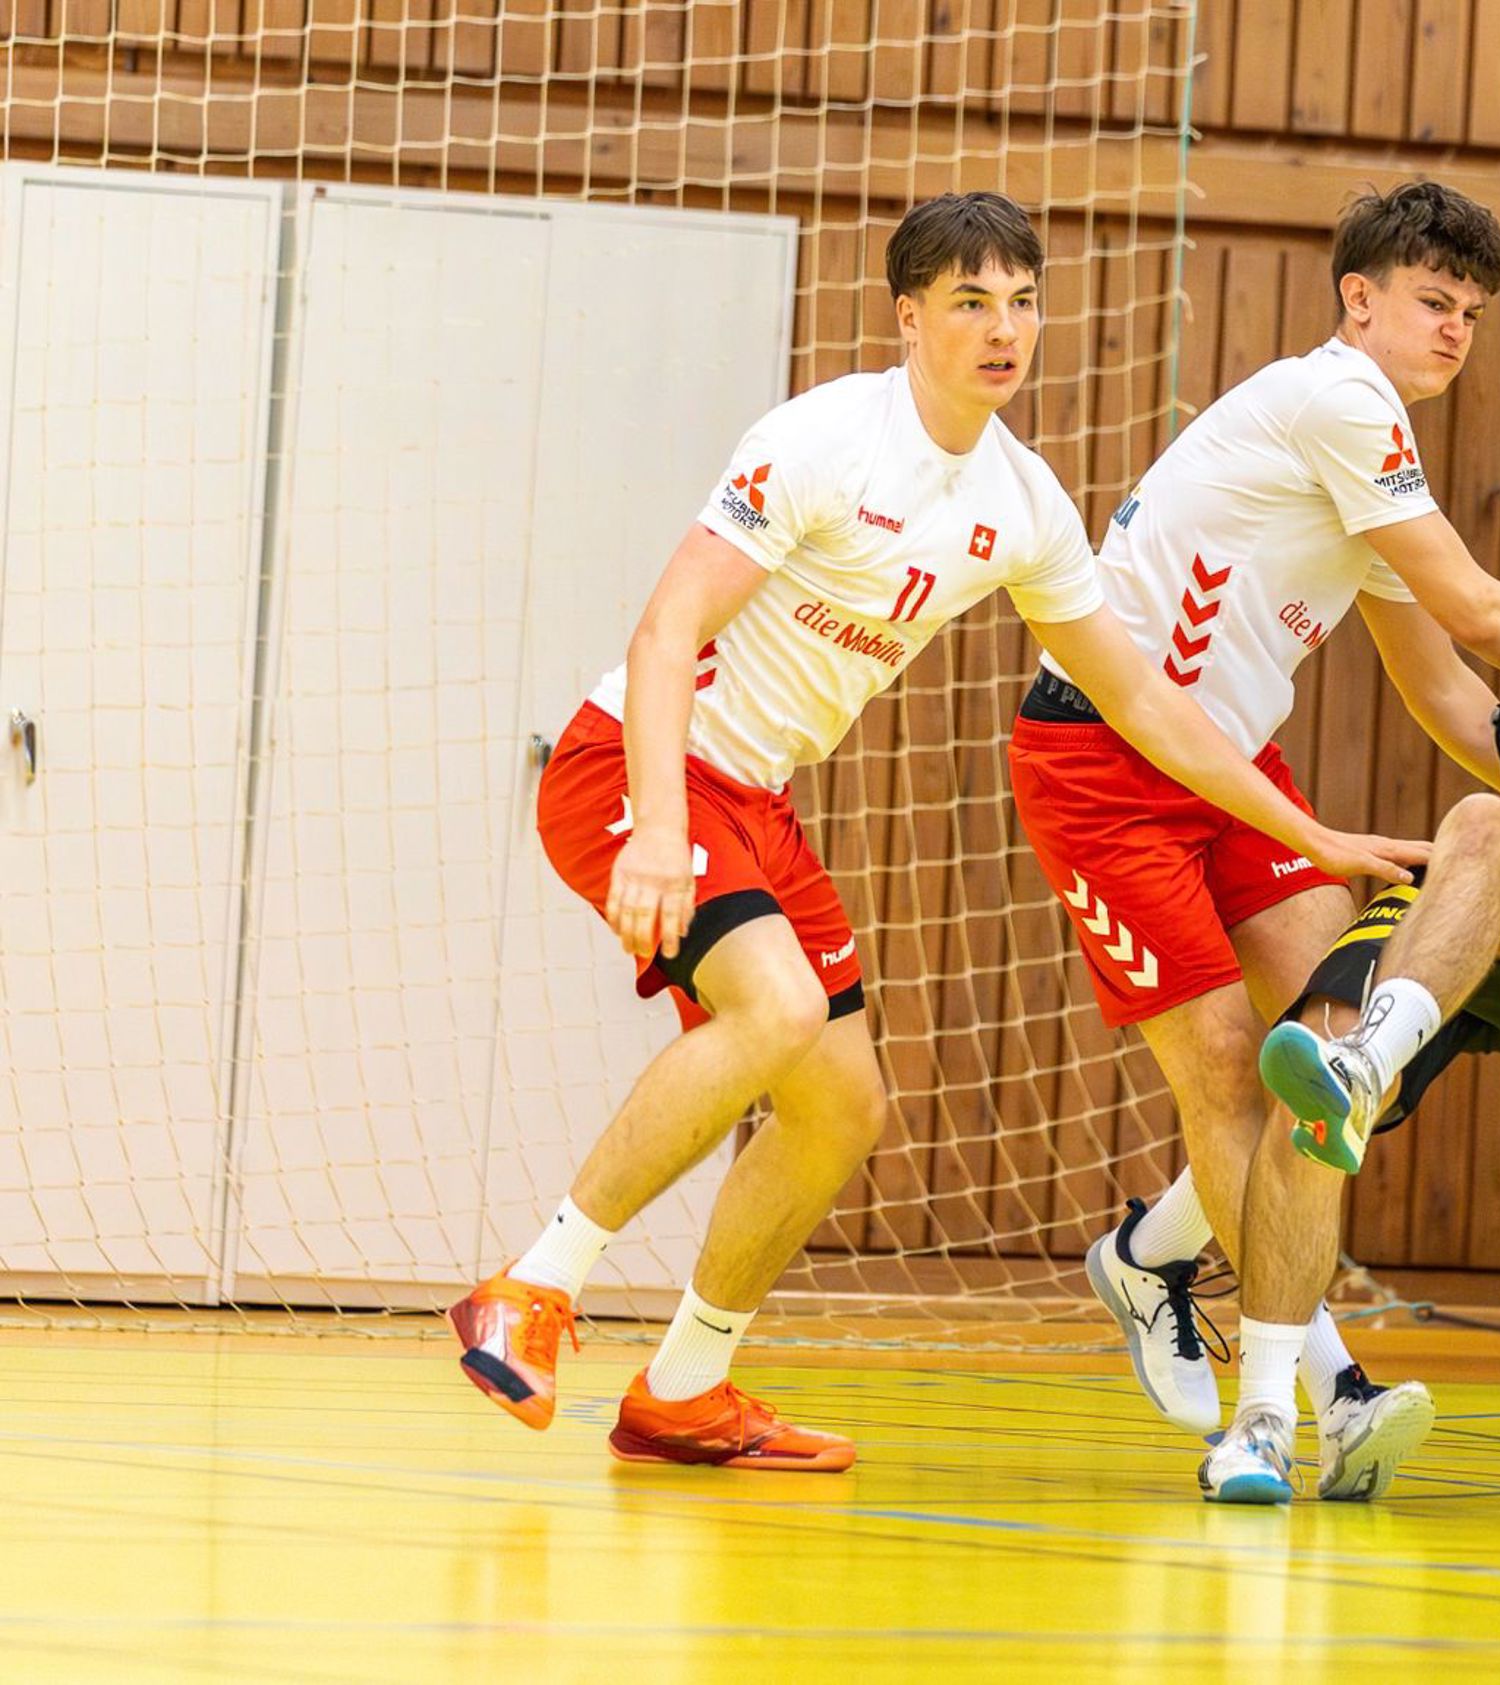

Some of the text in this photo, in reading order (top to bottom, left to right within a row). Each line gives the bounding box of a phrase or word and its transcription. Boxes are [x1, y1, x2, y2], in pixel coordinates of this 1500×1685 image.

[887, 565, 937, 623] 11
[794, 601, 840, 638] die
[1279, 600, 1311, 637] die
[1271, 856, 1314, 879] hum
